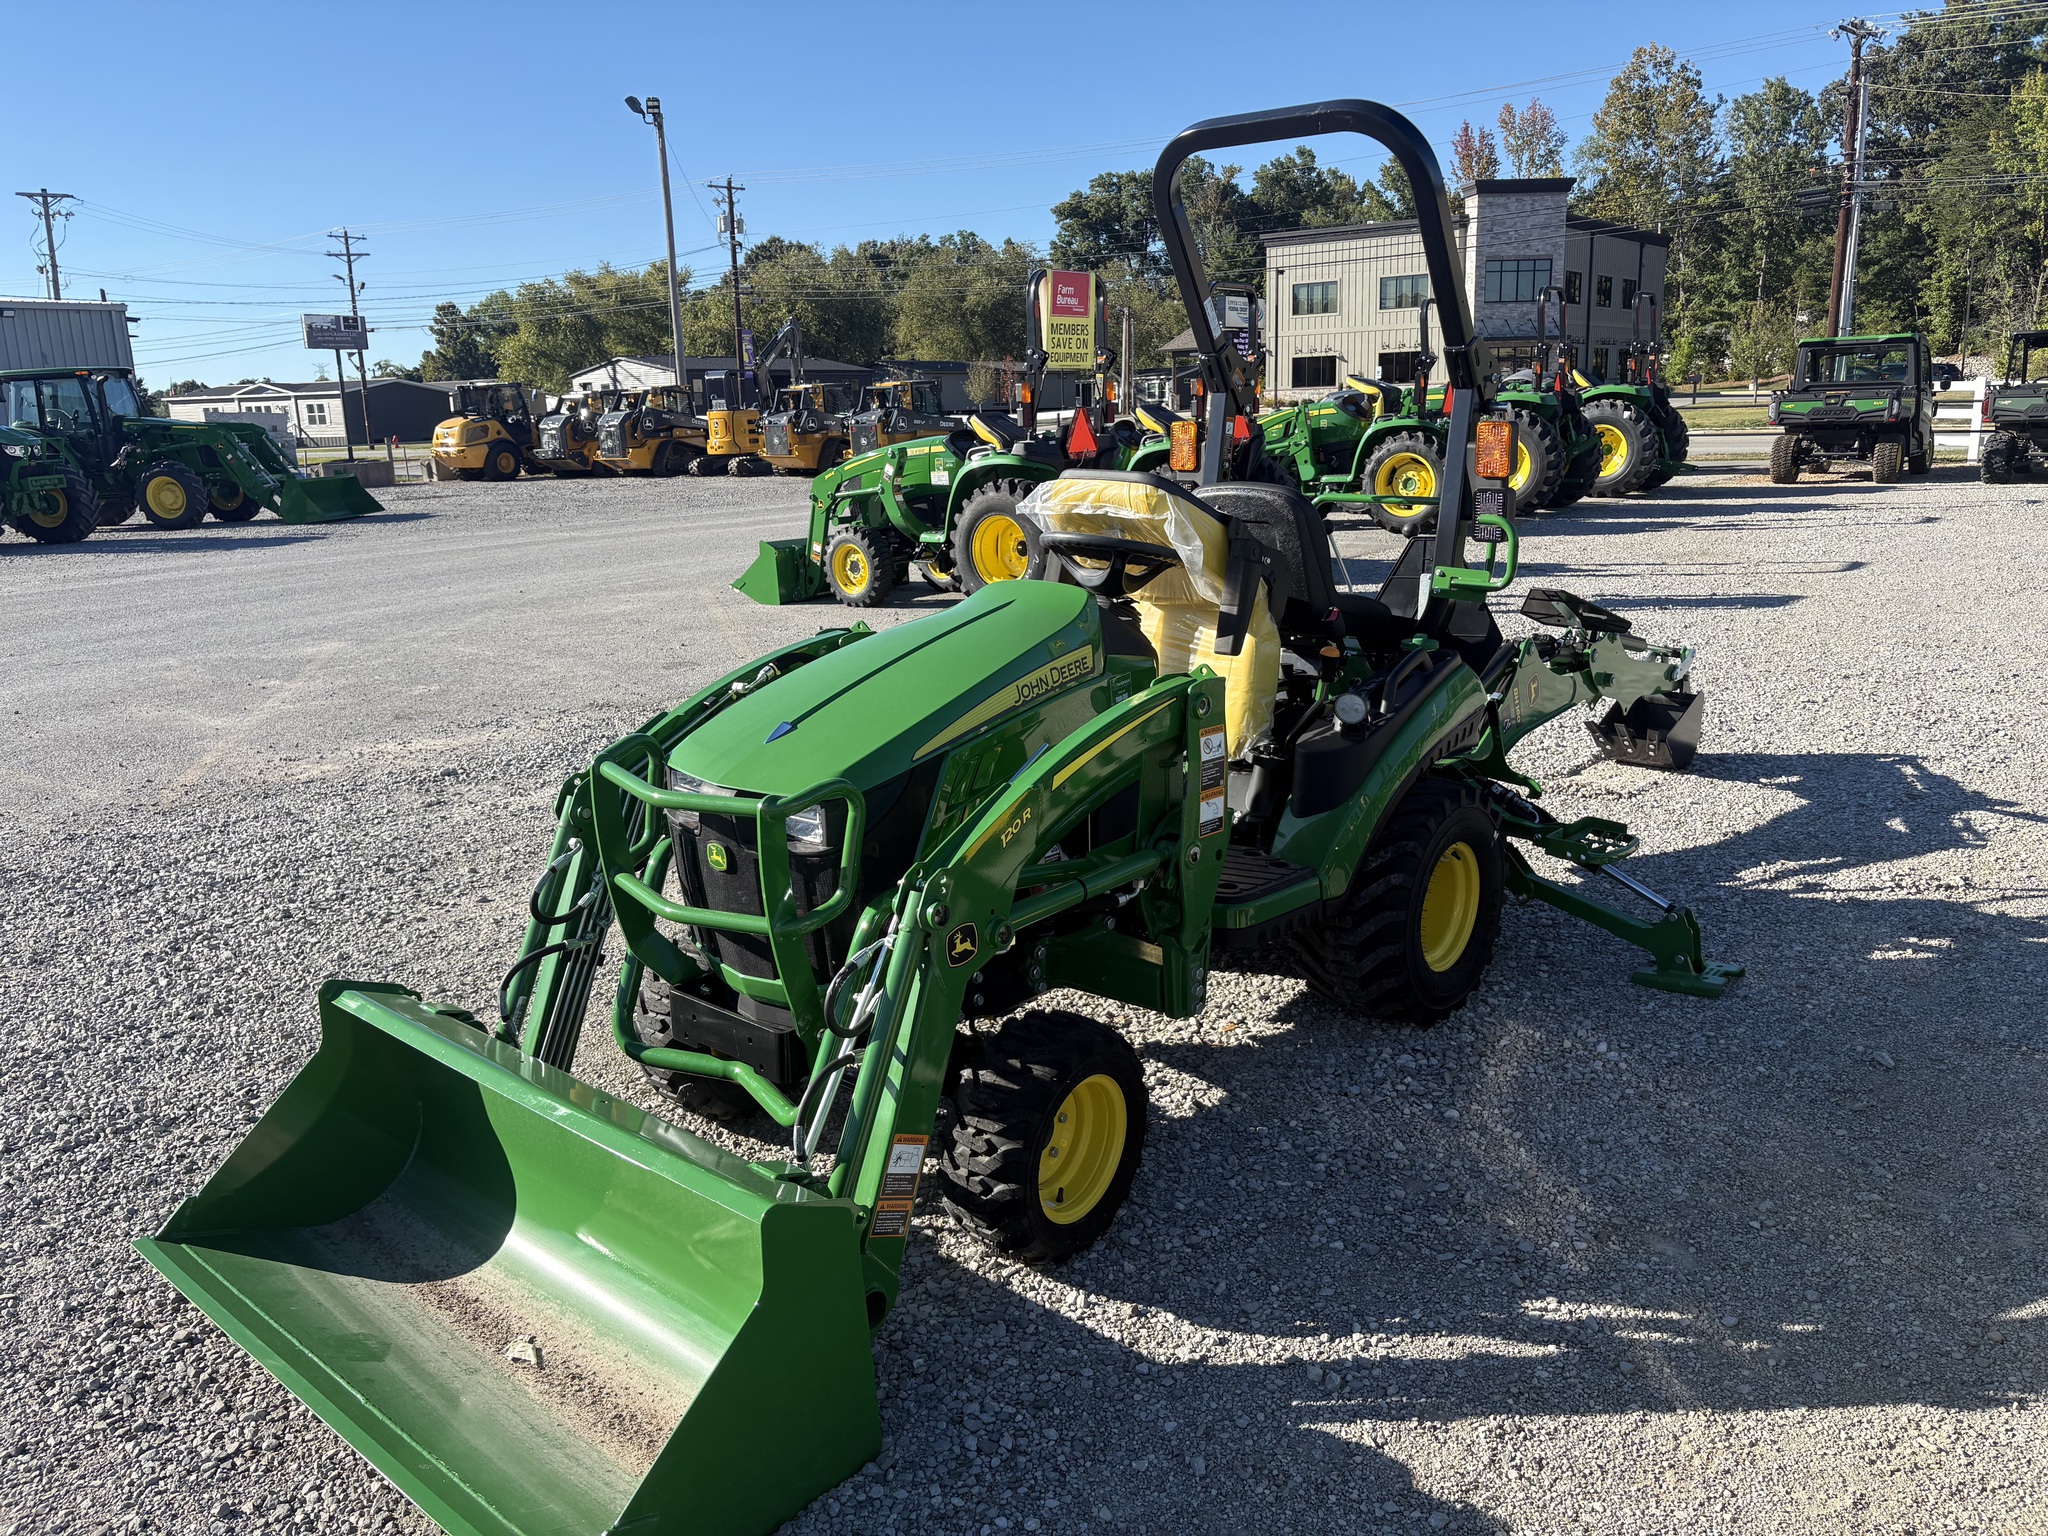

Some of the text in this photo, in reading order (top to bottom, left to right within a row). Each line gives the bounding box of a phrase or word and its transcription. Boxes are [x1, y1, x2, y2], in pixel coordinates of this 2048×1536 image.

[1057, 285, 1074, 295] Farm
[1056, 295, 1079, 305] Bureau
[1050, 323, 1089, 337] MEMBERS
[1051, 337, 1088, 350] SAVE ON
[1050, 352, 1089, 363] EQUIPMENT
[691, 418, 707, 427] DEERE
[939, 420, 955, 428] DEERE
[1014, 656, 1090, 704] JOHN DEERE
[1203, 725, 1224, 735] WARNING
[1204, 789, 1224, 799] WARNING
